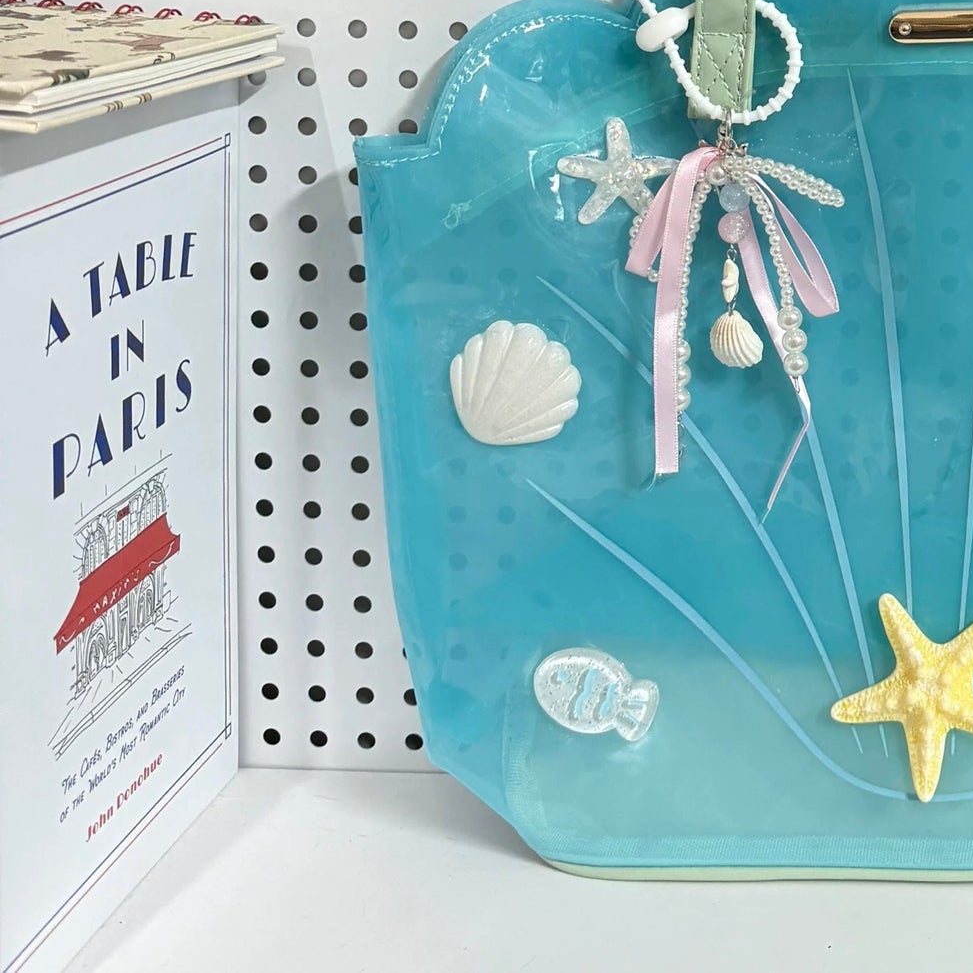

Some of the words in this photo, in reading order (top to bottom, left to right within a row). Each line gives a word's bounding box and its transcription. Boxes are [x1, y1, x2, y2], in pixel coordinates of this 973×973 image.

[45, 298, 71, 357] A
[83, 232, 197, 318] TABLE
[110, 319, 145, 381] IN
[52, 359, 192, 500] PARIS
[86, 805, 114, 843] John
[116, 753, 164, 811] Donohue
